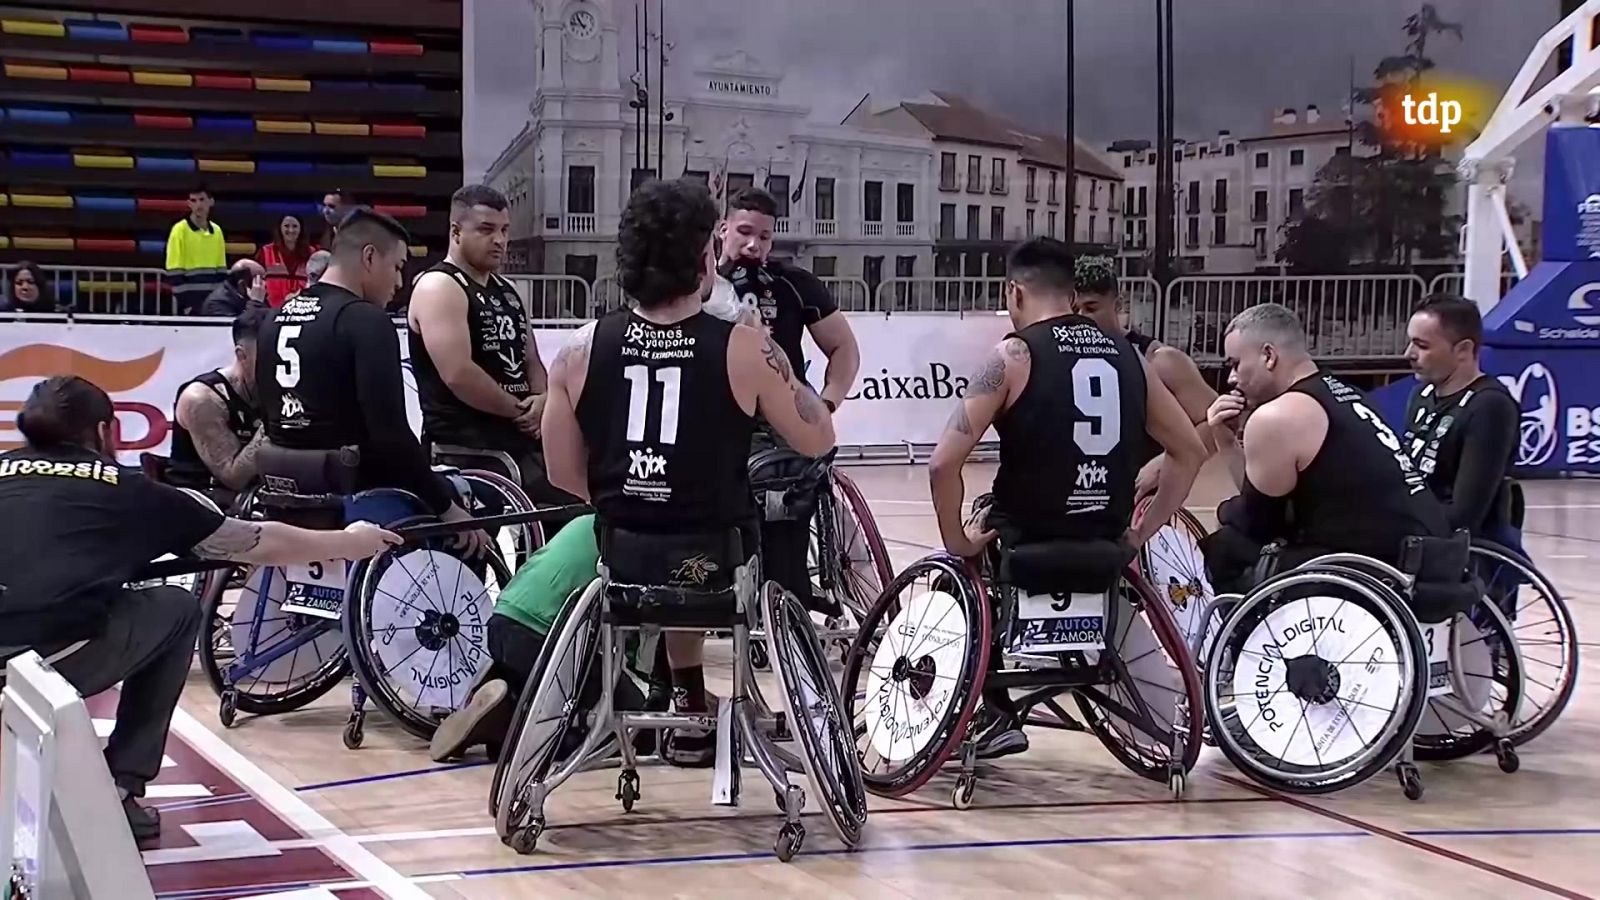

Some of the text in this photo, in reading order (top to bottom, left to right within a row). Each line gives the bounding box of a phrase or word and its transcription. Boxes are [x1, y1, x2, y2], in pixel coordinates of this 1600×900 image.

[708, 80, 771, 95] AYUNTAMIENTO
[496, 314, 516, 340] 23
[275, 325, 302, 388] 5
[845, 362, 970, 401] aixaBa
[624, 364, 682, 445] 11
[1071, 358, 1121, 456] 9
[1352, 402, 1401, 451] 3
[311, 587, 343, 600] AUTOS
[1052, 630, 1104, 643] ZAMORA
[1055, 618, 1099, 631] AUTOS
